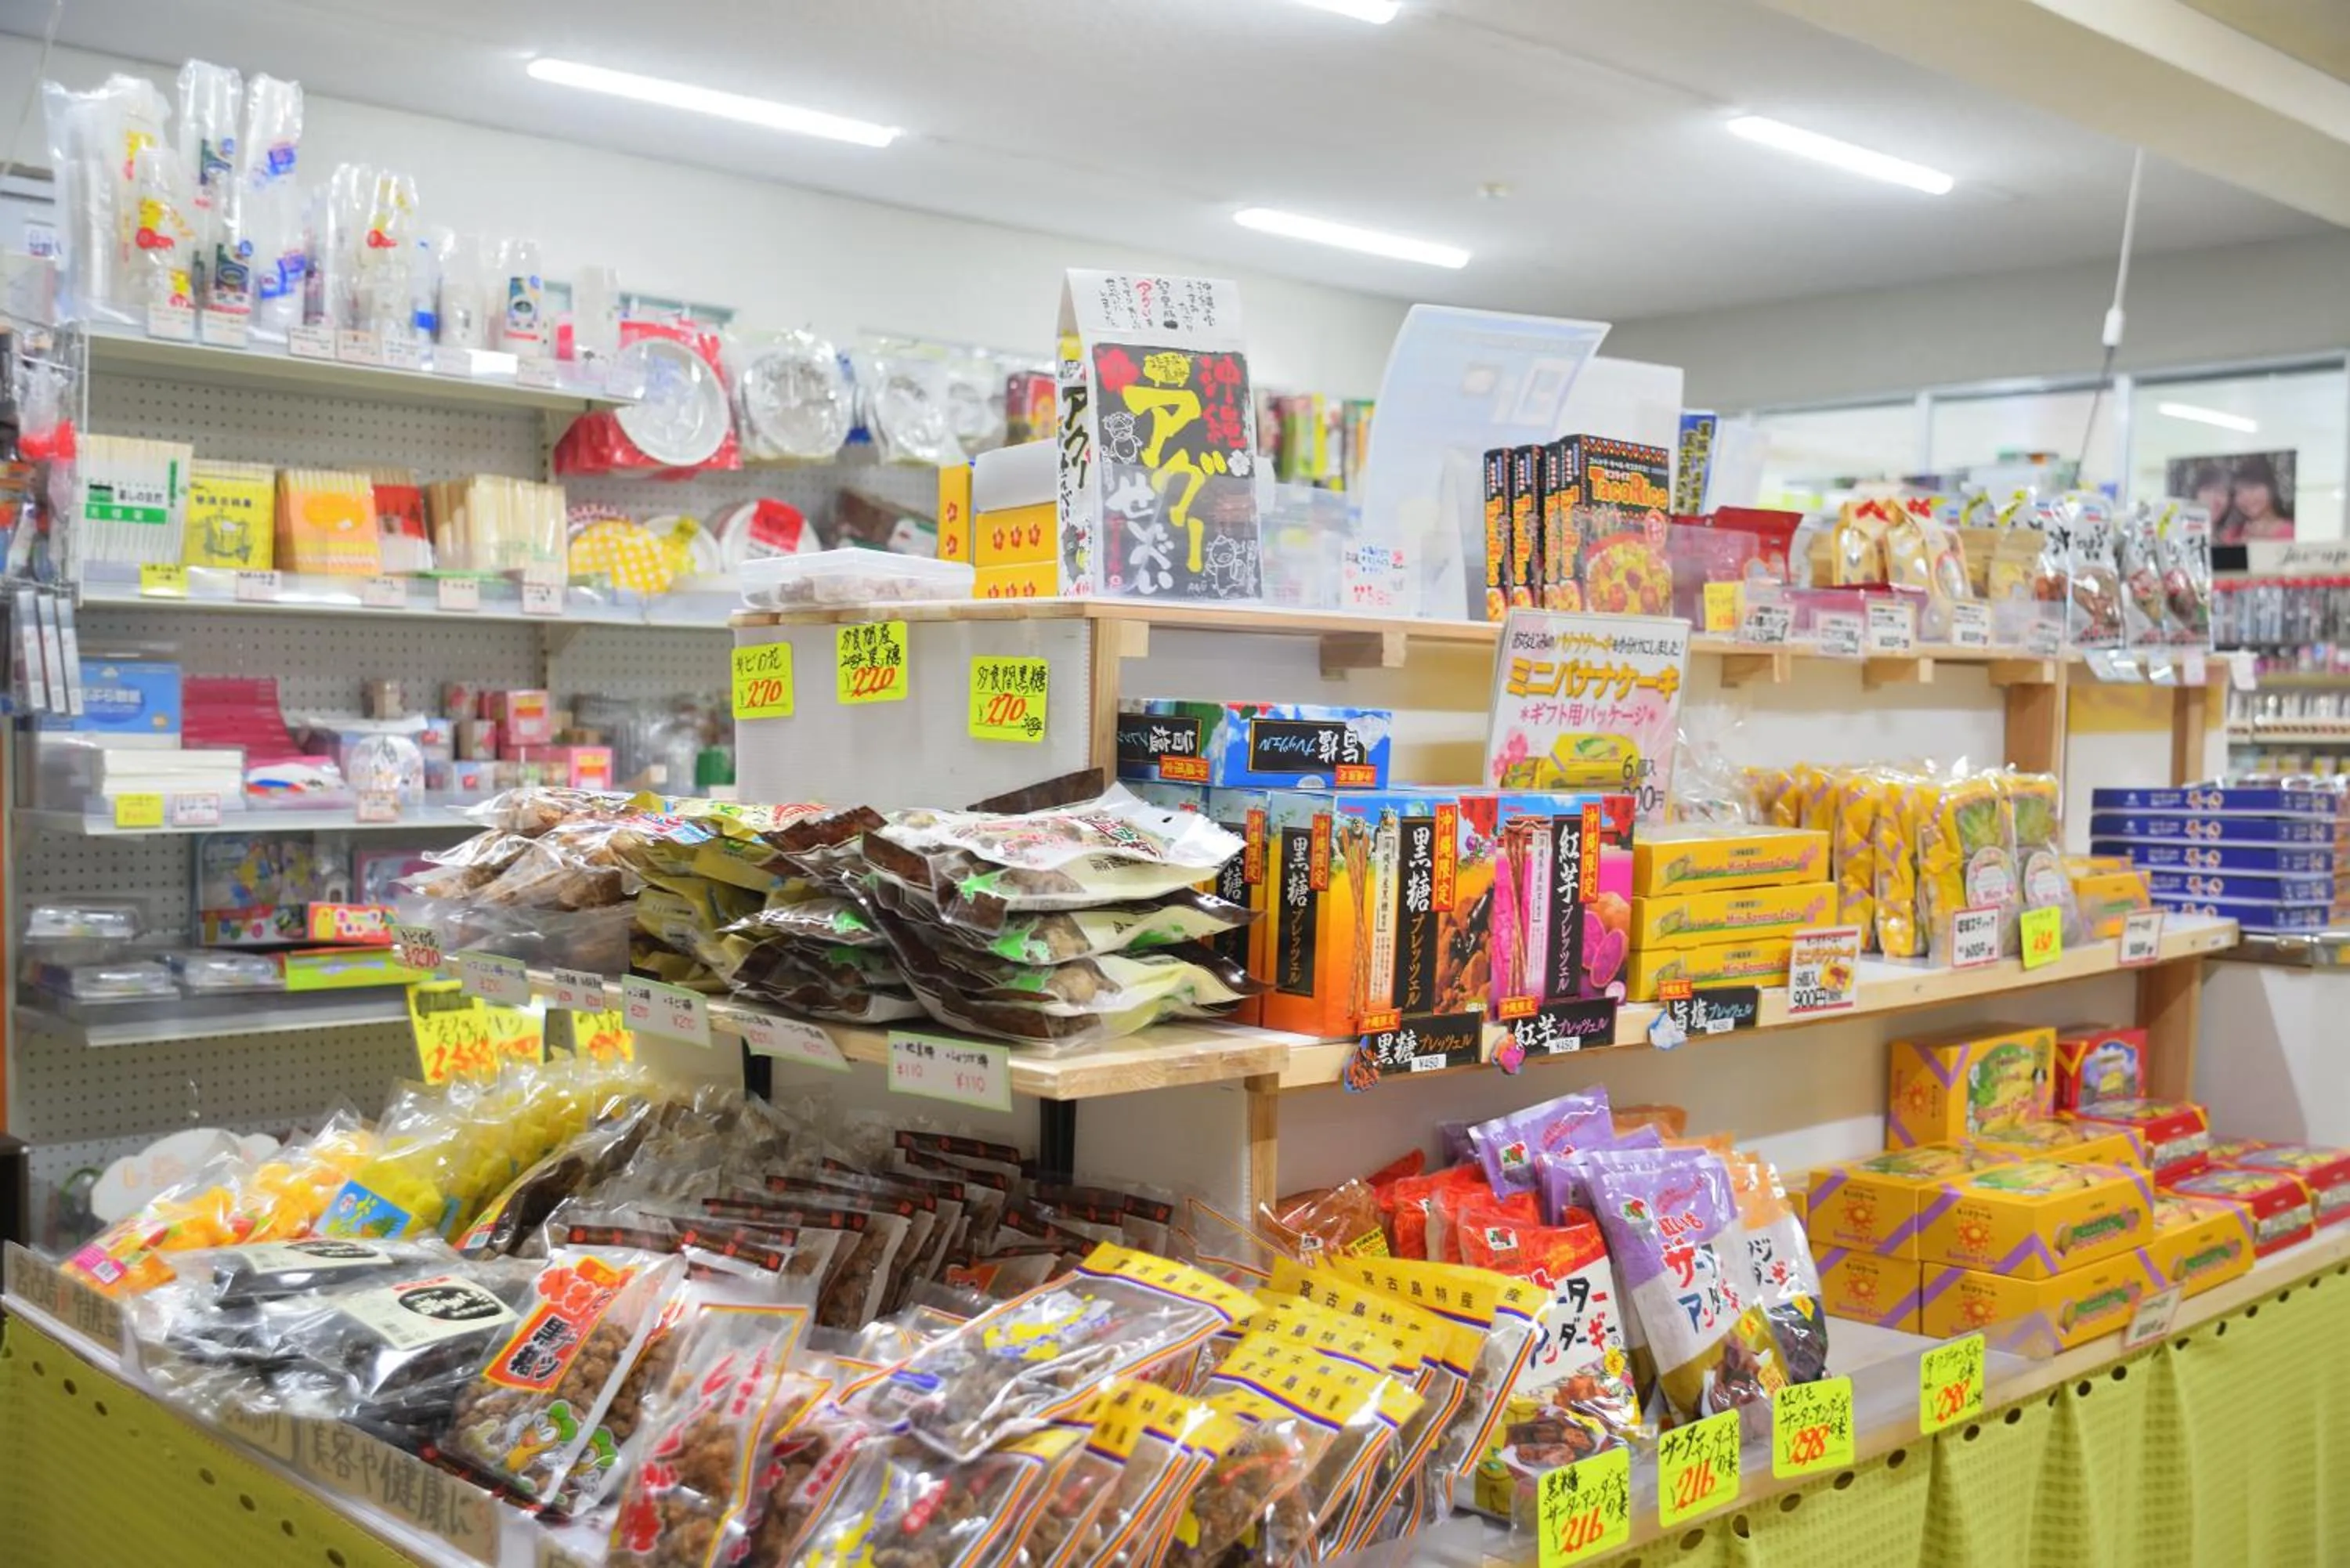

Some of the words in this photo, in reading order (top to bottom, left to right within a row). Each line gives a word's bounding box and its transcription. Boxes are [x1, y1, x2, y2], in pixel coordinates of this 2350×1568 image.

[1506, 656, 1680, 703] ミニバナナケーキ
[1437, 810, 1455, 907] 沖縄限定
[1582, 807, 1599, 901] 沖縄限定
[1362, 1270, 1474, 1310] 宮古島特産
